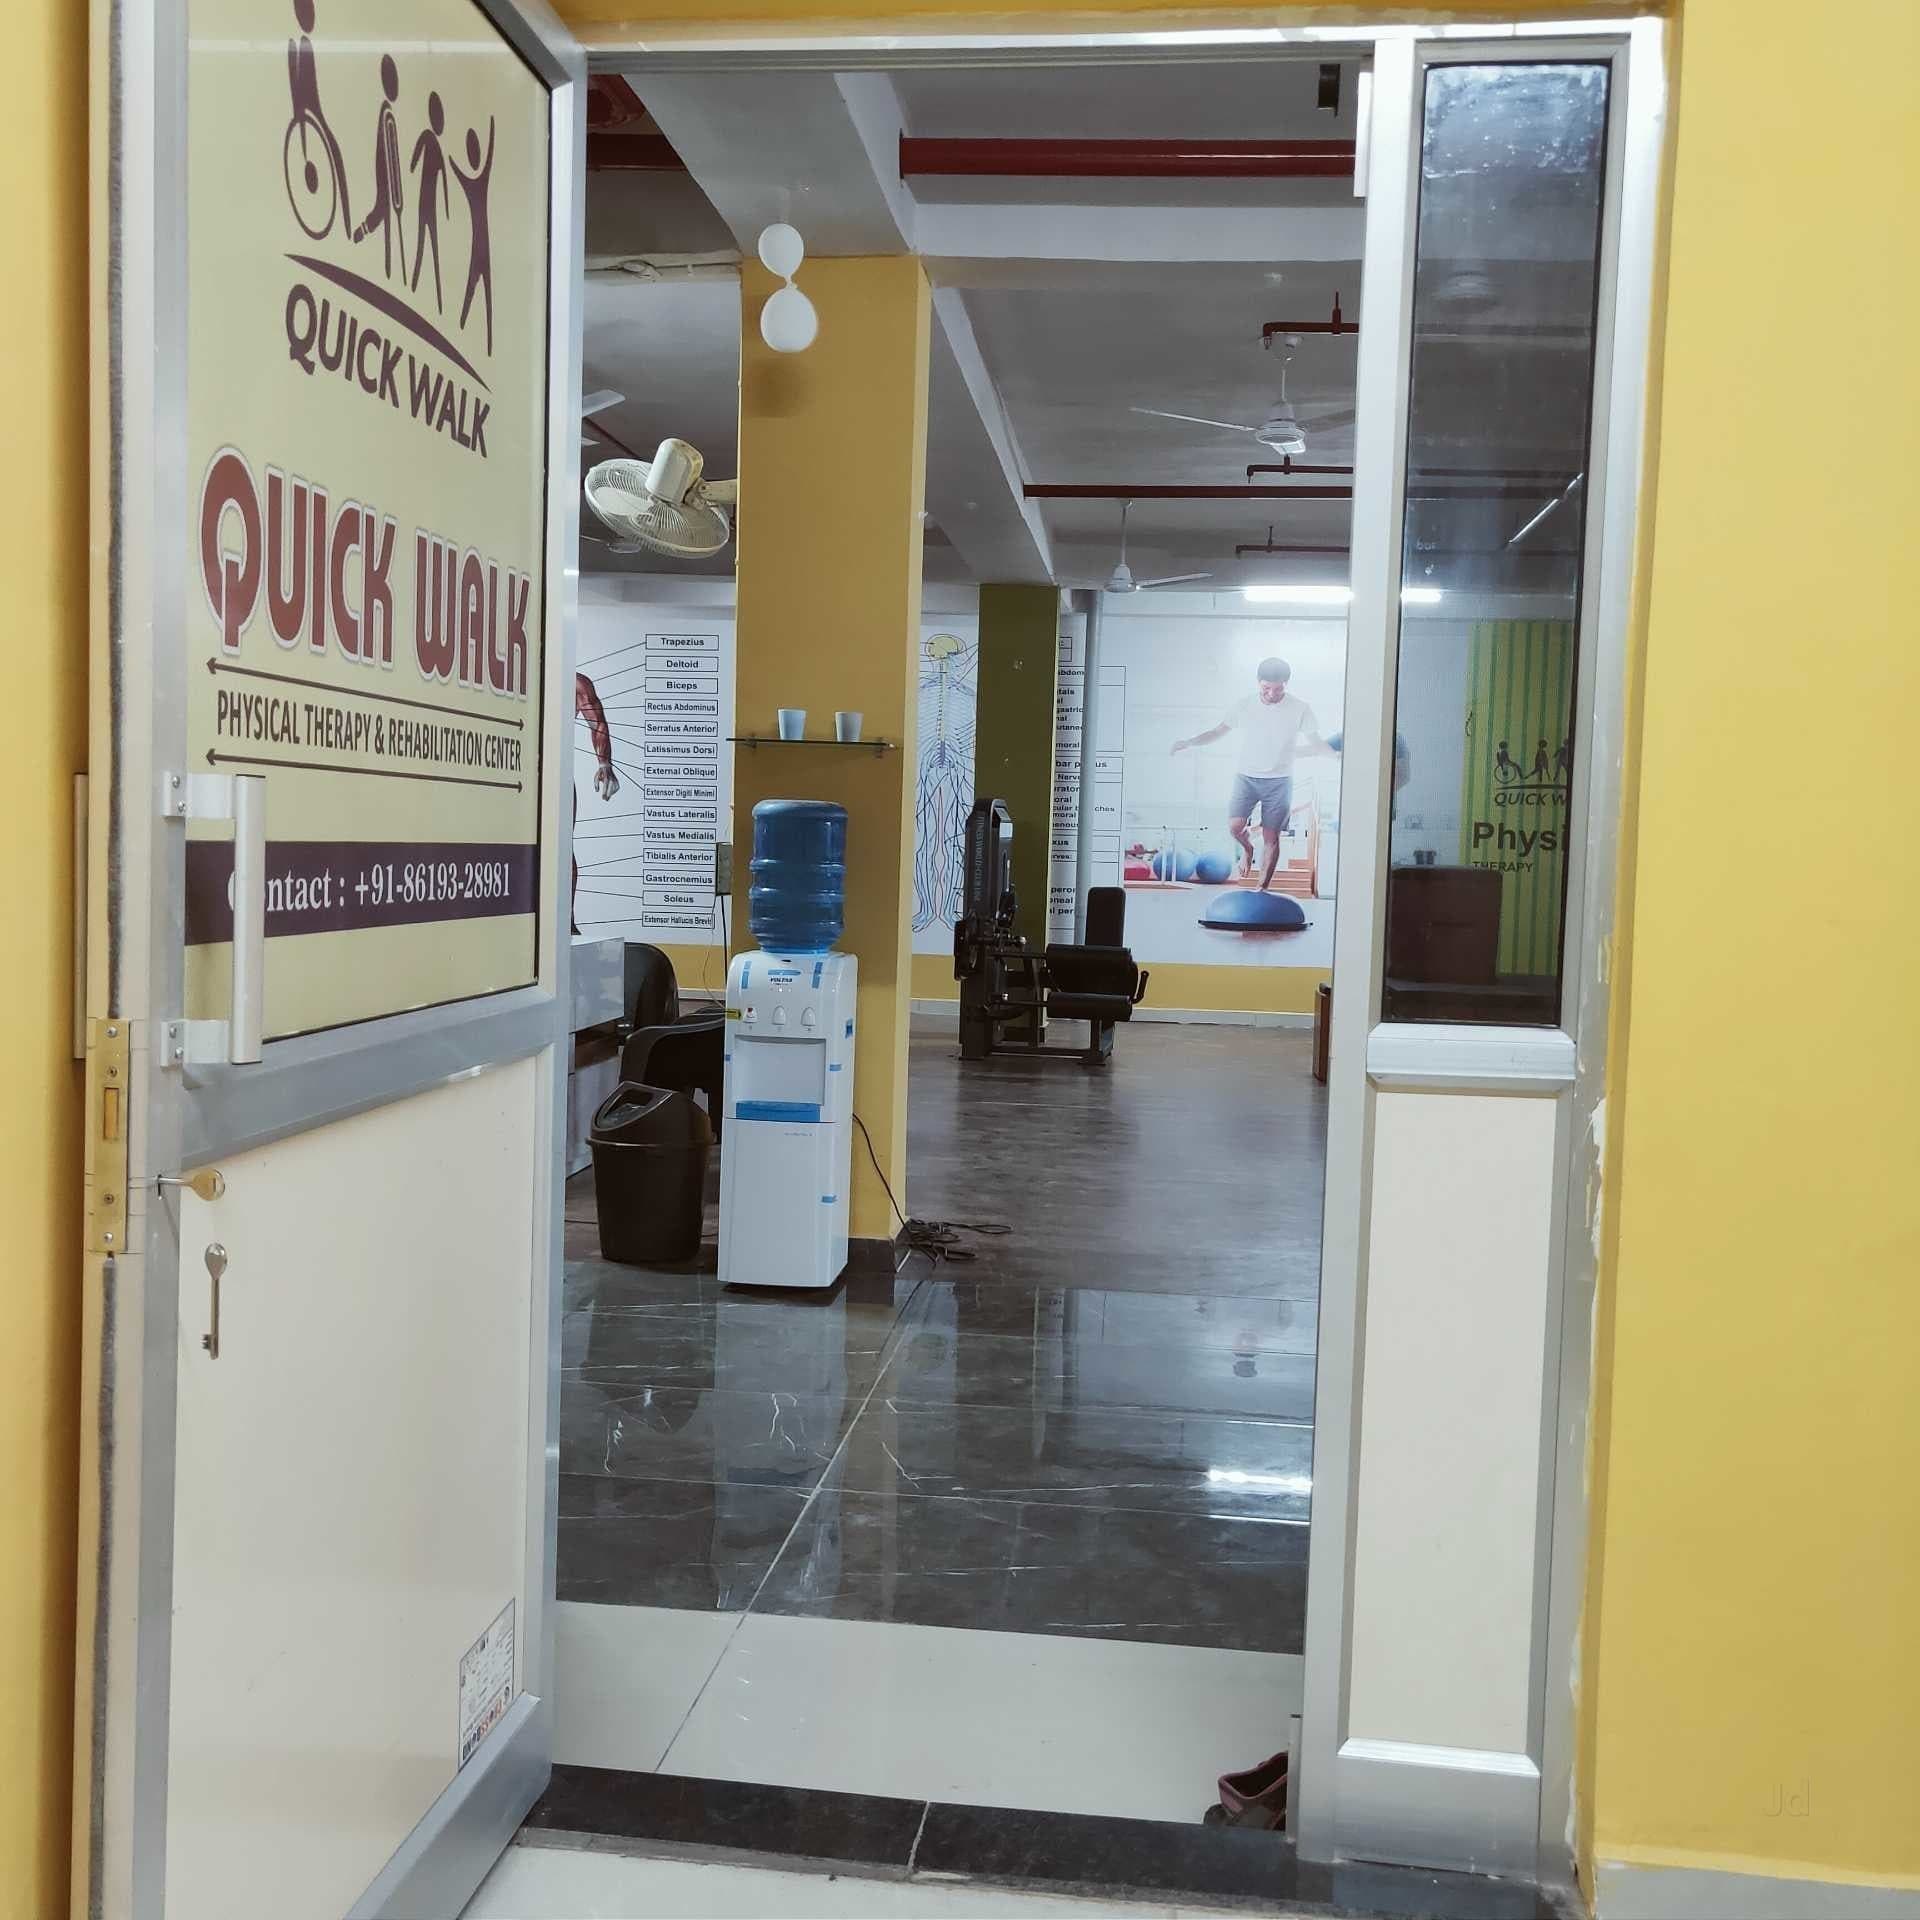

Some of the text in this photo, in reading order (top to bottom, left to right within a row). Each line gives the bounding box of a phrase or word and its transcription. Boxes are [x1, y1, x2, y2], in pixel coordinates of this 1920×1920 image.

[286, 283, 490, 458] QUICK WALK
[200, 444, 530, 698] QUICK WALK
[660, 637, 705, 647] Trapezius
[666, 660, 699, 669] Deltoid
[666, 681, 698, 691] Biceps
[647, 702, 716, 712] Rectus Abdominus
[217, 689, 522, 771] PHYSICAL THERAPY & REHABILITATION CENTER
[647, 724, 716, 733] Serratus Anterior
[646, 745, 715, 754] Latissimus Dorsi
[646, 766, 715, 777] External Oblique
[646, 788, 674, 796] Extensor
[1494, 792, 1549, 807] QUICK
[646, 809, 715, 819] Vastus Lateralis
[646, 831, 714, 840] Vastus Medialis
[646, 852, 713, 861] Tibialis Anterior
[645, 874, 713, 884] Gastrocnemius
[228, 867, 332, 912] ntact
[354, 862, 510, 905] +91-86193-28981
[663, 895, 695, 903] Soleus
[644, 915, 670, 924] Extensor
